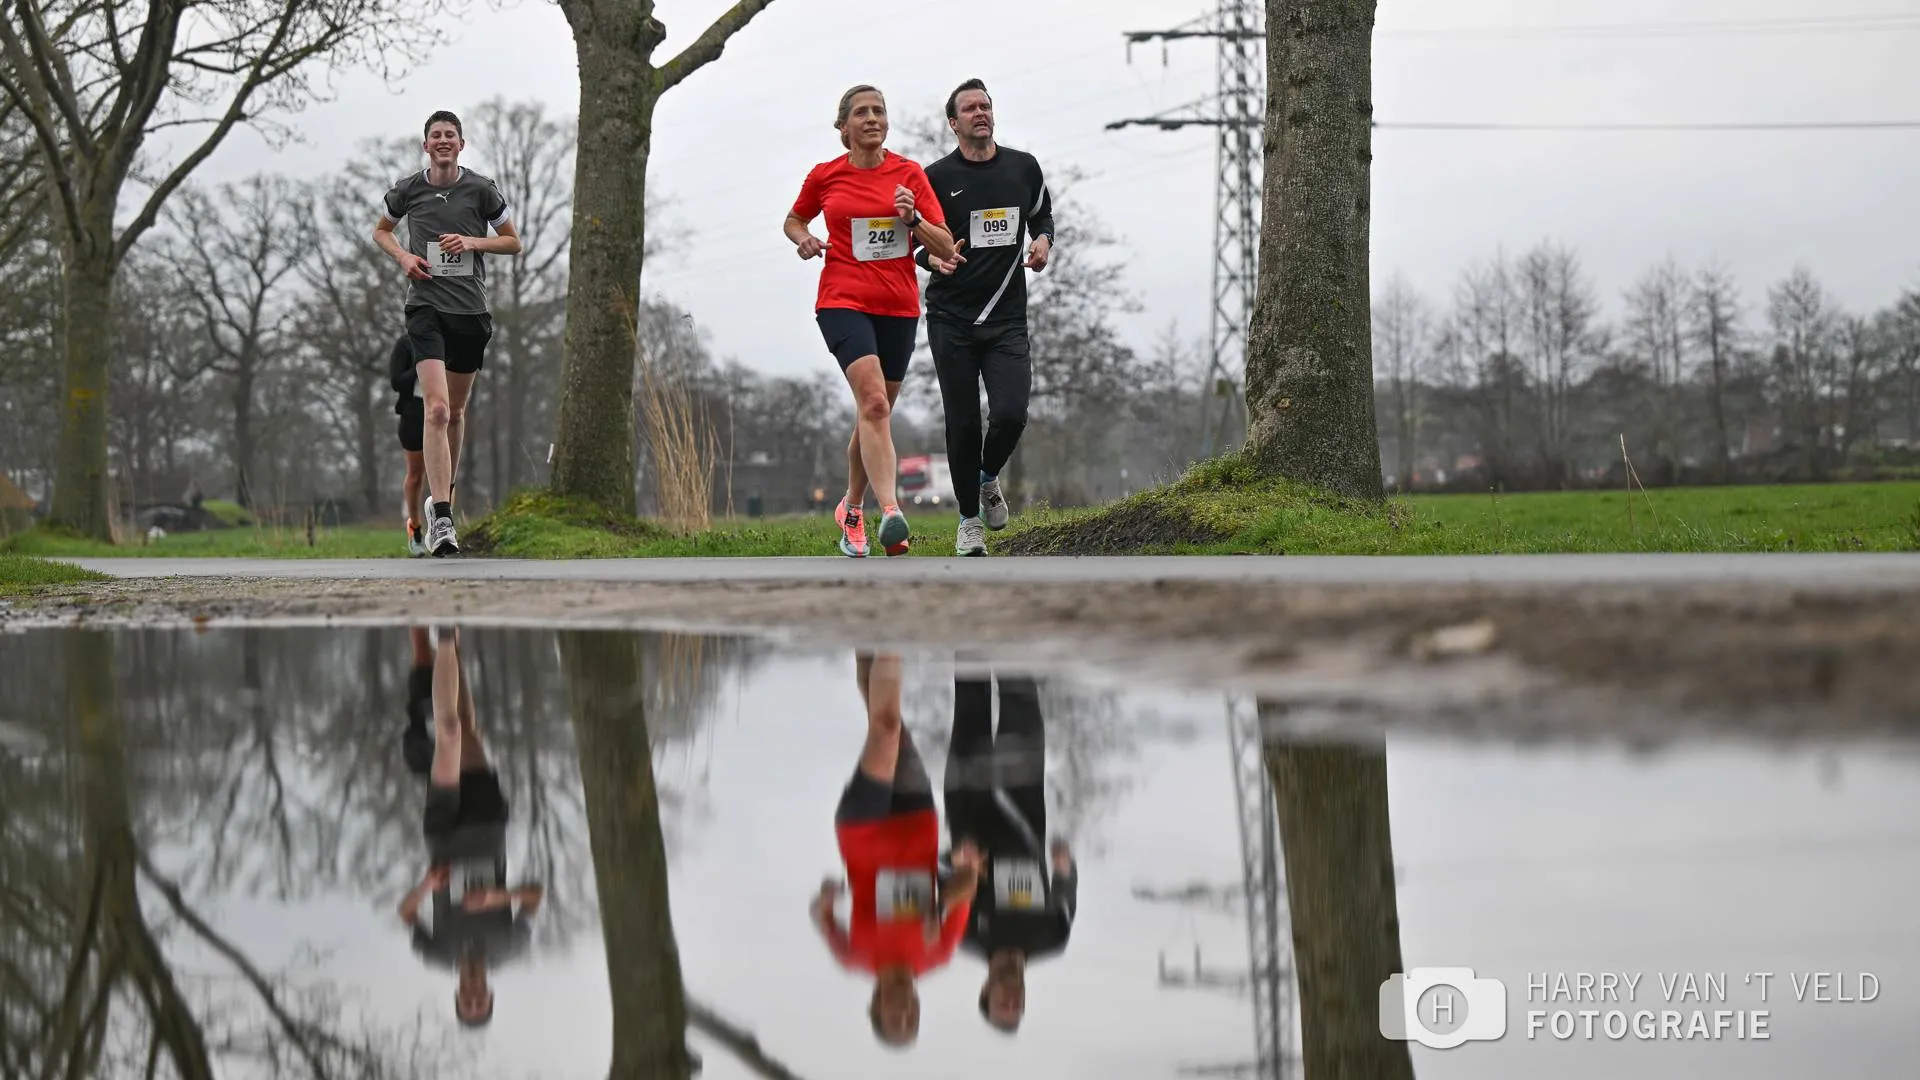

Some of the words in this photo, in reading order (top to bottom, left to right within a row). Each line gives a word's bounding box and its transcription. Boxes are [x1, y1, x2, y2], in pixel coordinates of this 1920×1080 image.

[983, 219, 1008, 232] 099
[868, 230, 895, 244] 242
[440, 252, 461, 263] 123
